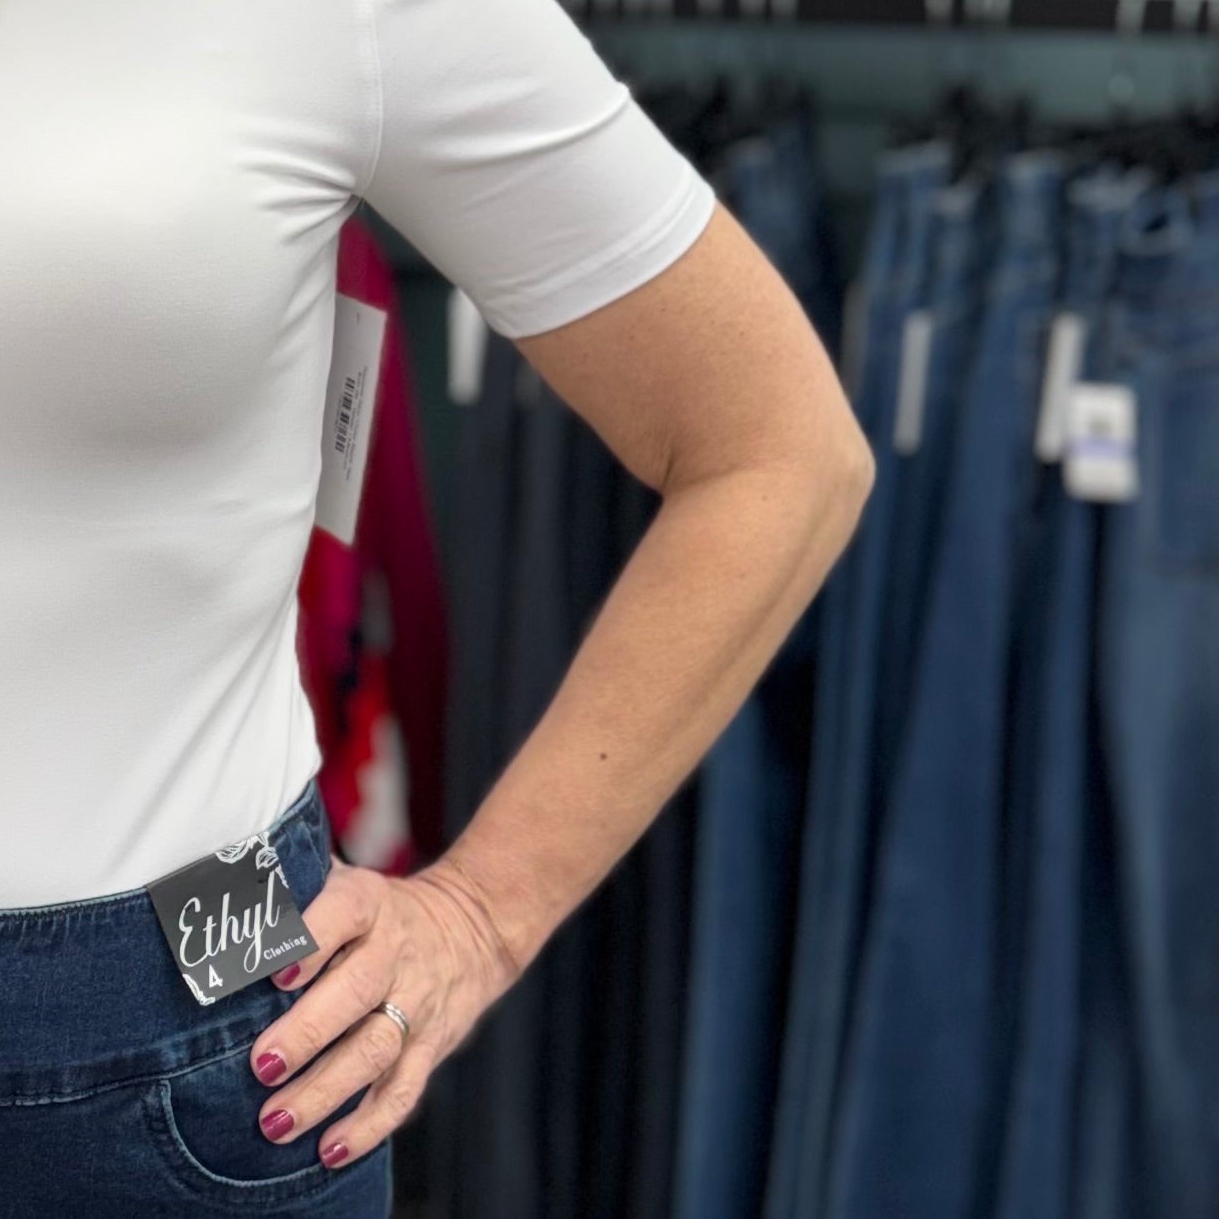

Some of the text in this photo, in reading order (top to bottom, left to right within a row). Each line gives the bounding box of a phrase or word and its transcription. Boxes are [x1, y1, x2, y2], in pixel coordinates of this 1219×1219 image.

[179, 870, 280, 973] Ethyl
[263, 935, 308, 960] Clothing
[208, 963, 224, 988] 4
